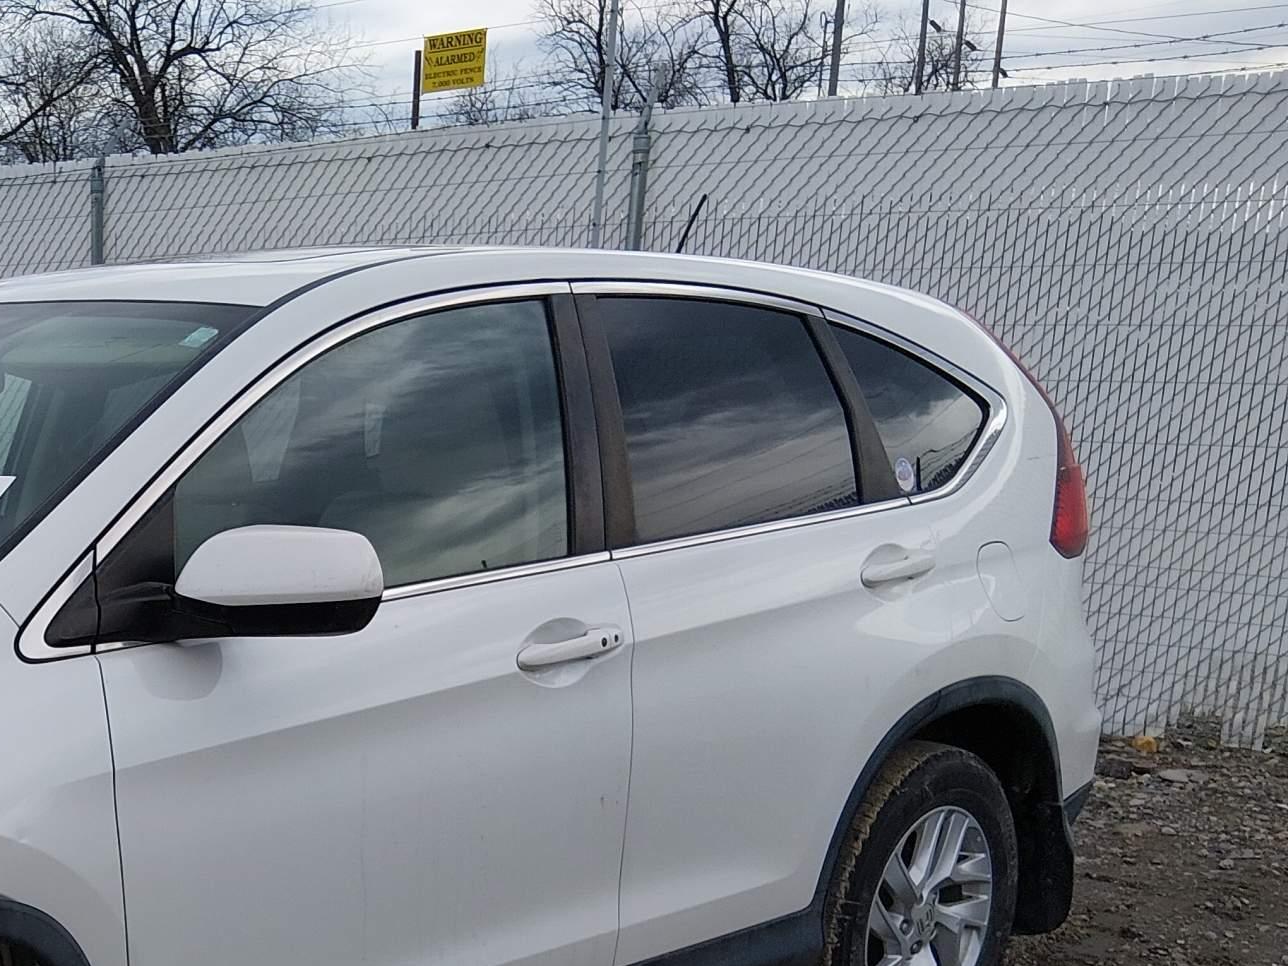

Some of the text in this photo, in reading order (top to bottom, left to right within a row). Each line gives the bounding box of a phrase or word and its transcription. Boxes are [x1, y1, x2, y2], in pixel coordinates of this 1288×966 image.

[428, 31, 482, 50] WARNING
[434, 51, 475, 67] ALARMED
[425, 66, 482, 80] ELECTRIC FENCE
[452, 77, 474, 86] VOLTS
